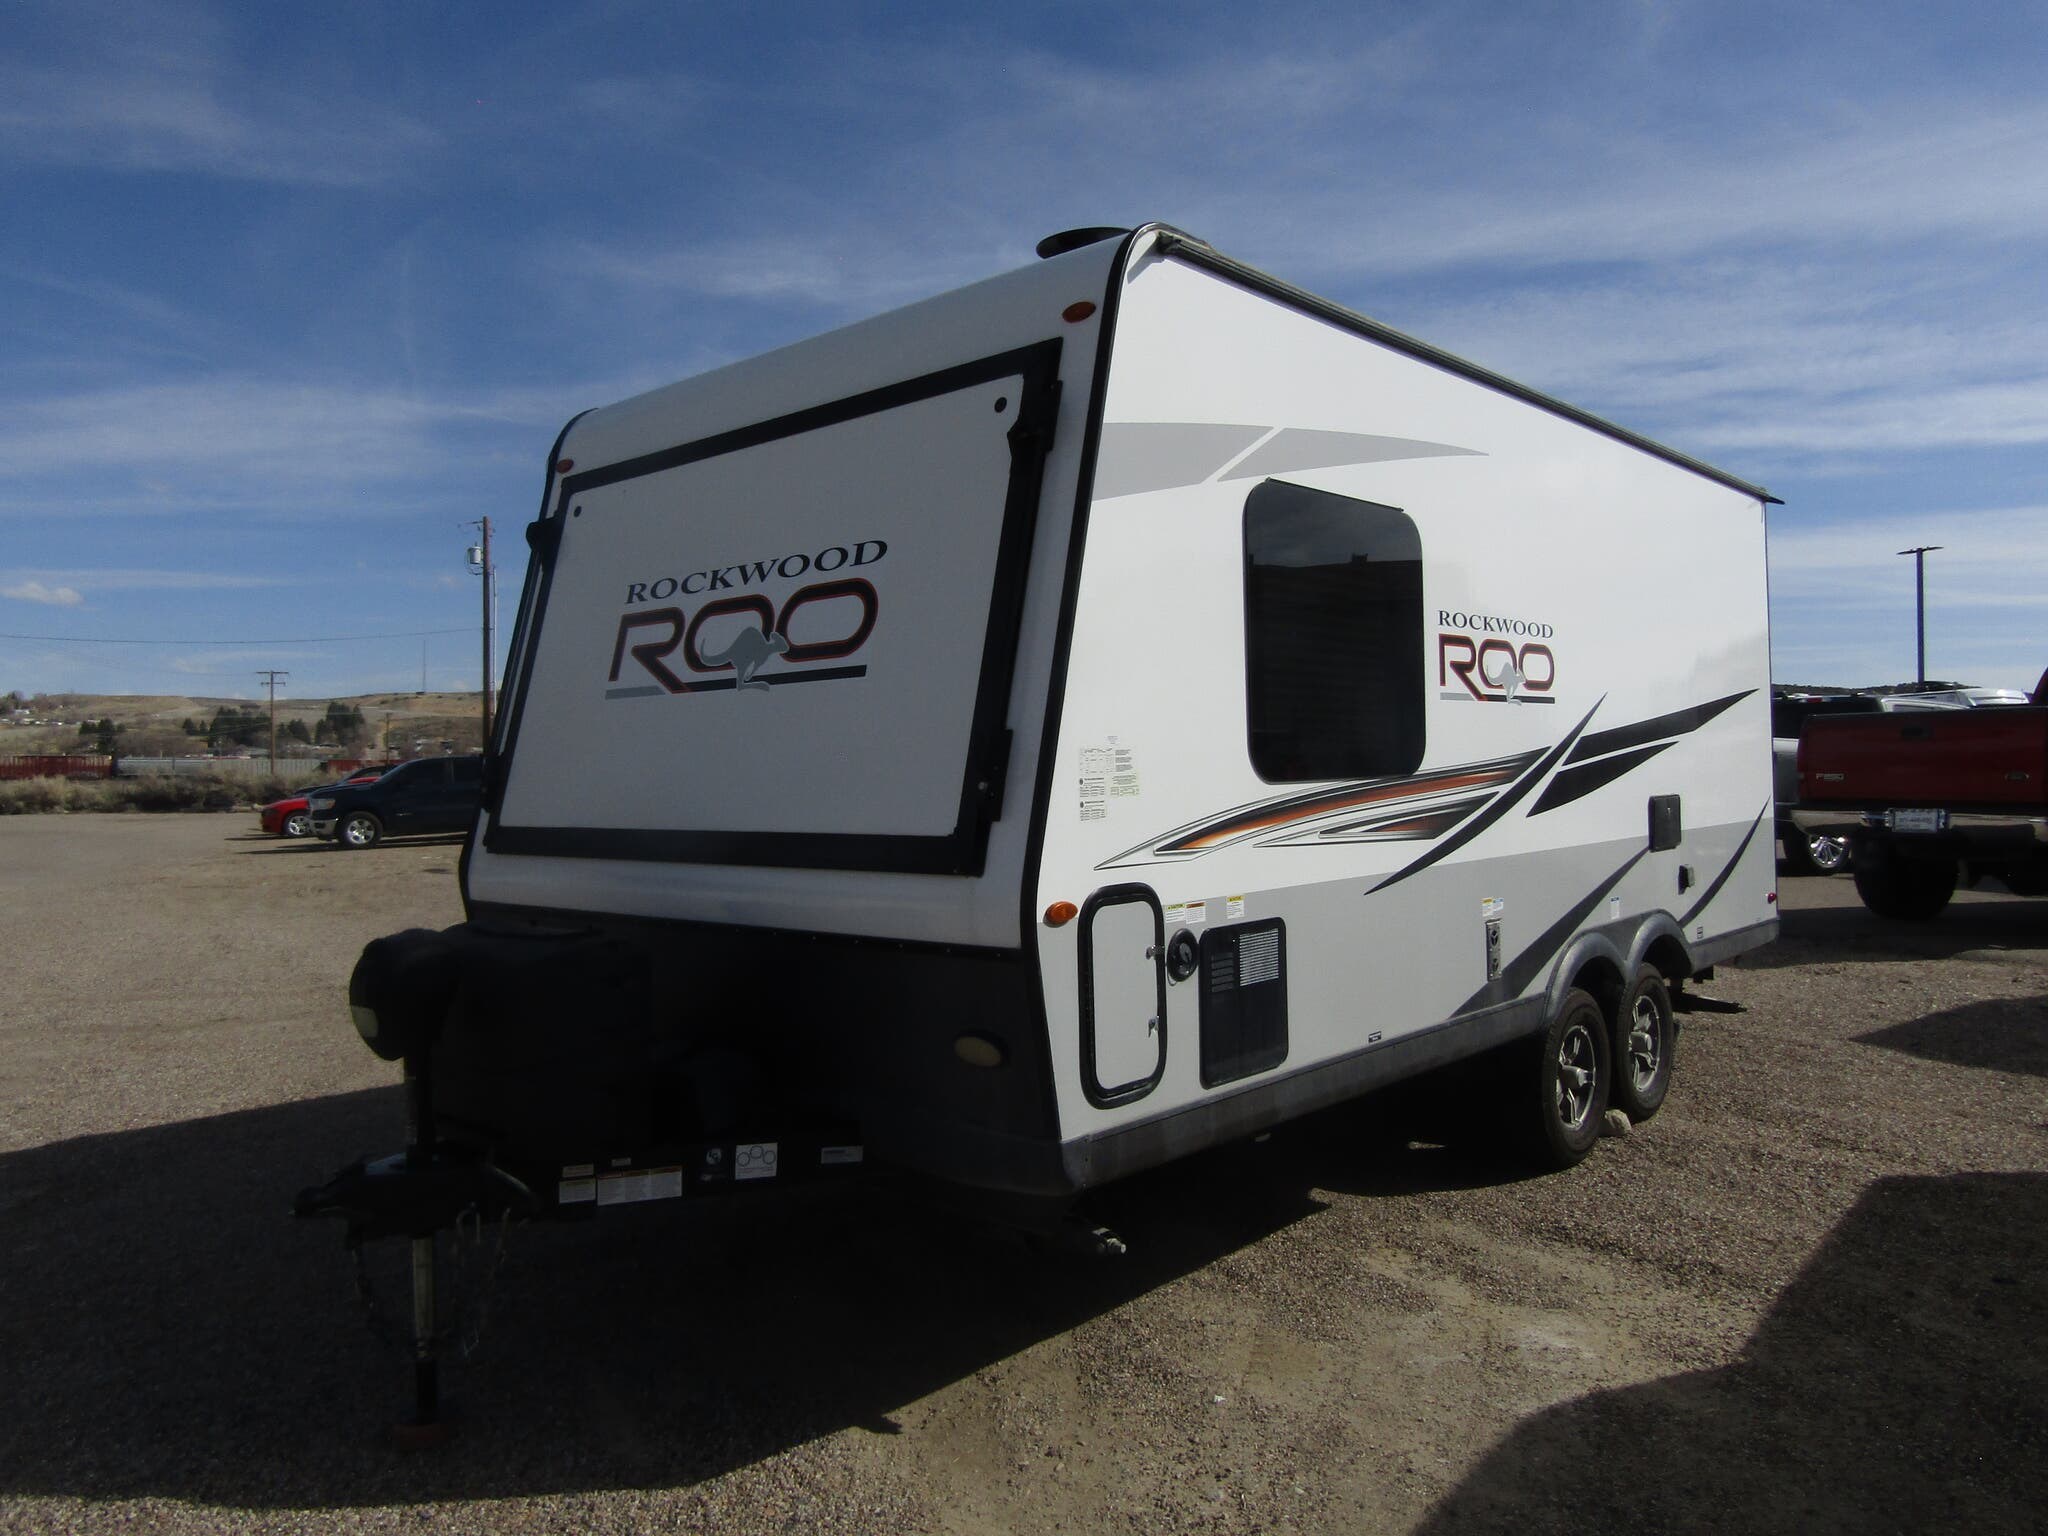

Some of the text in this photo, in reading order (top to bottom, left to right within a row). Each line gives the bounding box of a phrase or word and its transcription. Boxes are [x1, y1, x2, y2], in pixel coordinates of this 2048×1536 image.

[626, 539, 888, 605] ROCKWOOD
[608, 577, 879, 694] ROO
[1438, 610, 1554, 638] ROCKWOOD
[1439, 633, 1555, 701] ROO
